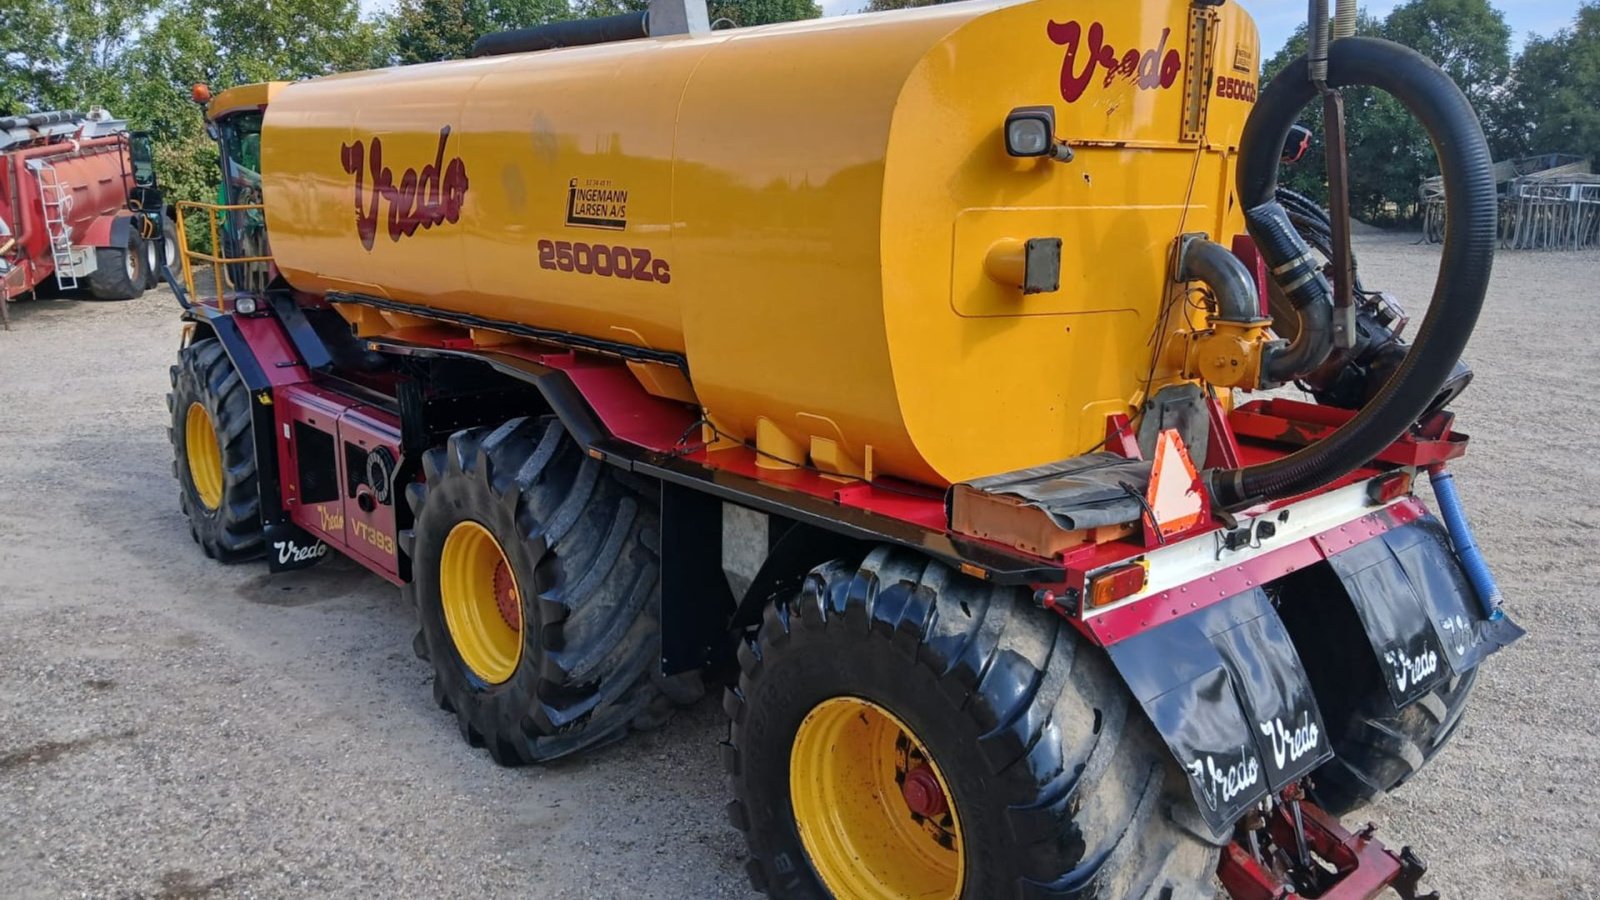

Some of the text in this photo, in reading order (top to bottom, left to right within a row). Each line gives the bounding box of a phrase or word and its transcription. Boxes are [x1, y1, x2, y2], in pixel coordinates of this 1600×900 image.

[341, 124, 469, 251] Vredo
[577, 188, 628, 203] INGEMANN
[575, 203, 626, 218] LARSEN A/S
[537, 239, 671, 284] 25000Zc
[317, 504, 344, 531] Vredo
[352, 518, 396, 555] VT393
[274, 538, 328, 564] Vredo
[1384, 640, 1437, 692] Vredo
[1260, 711, 1319, 770] Vredo
[1187, 744, 1259, 812] Vredo
